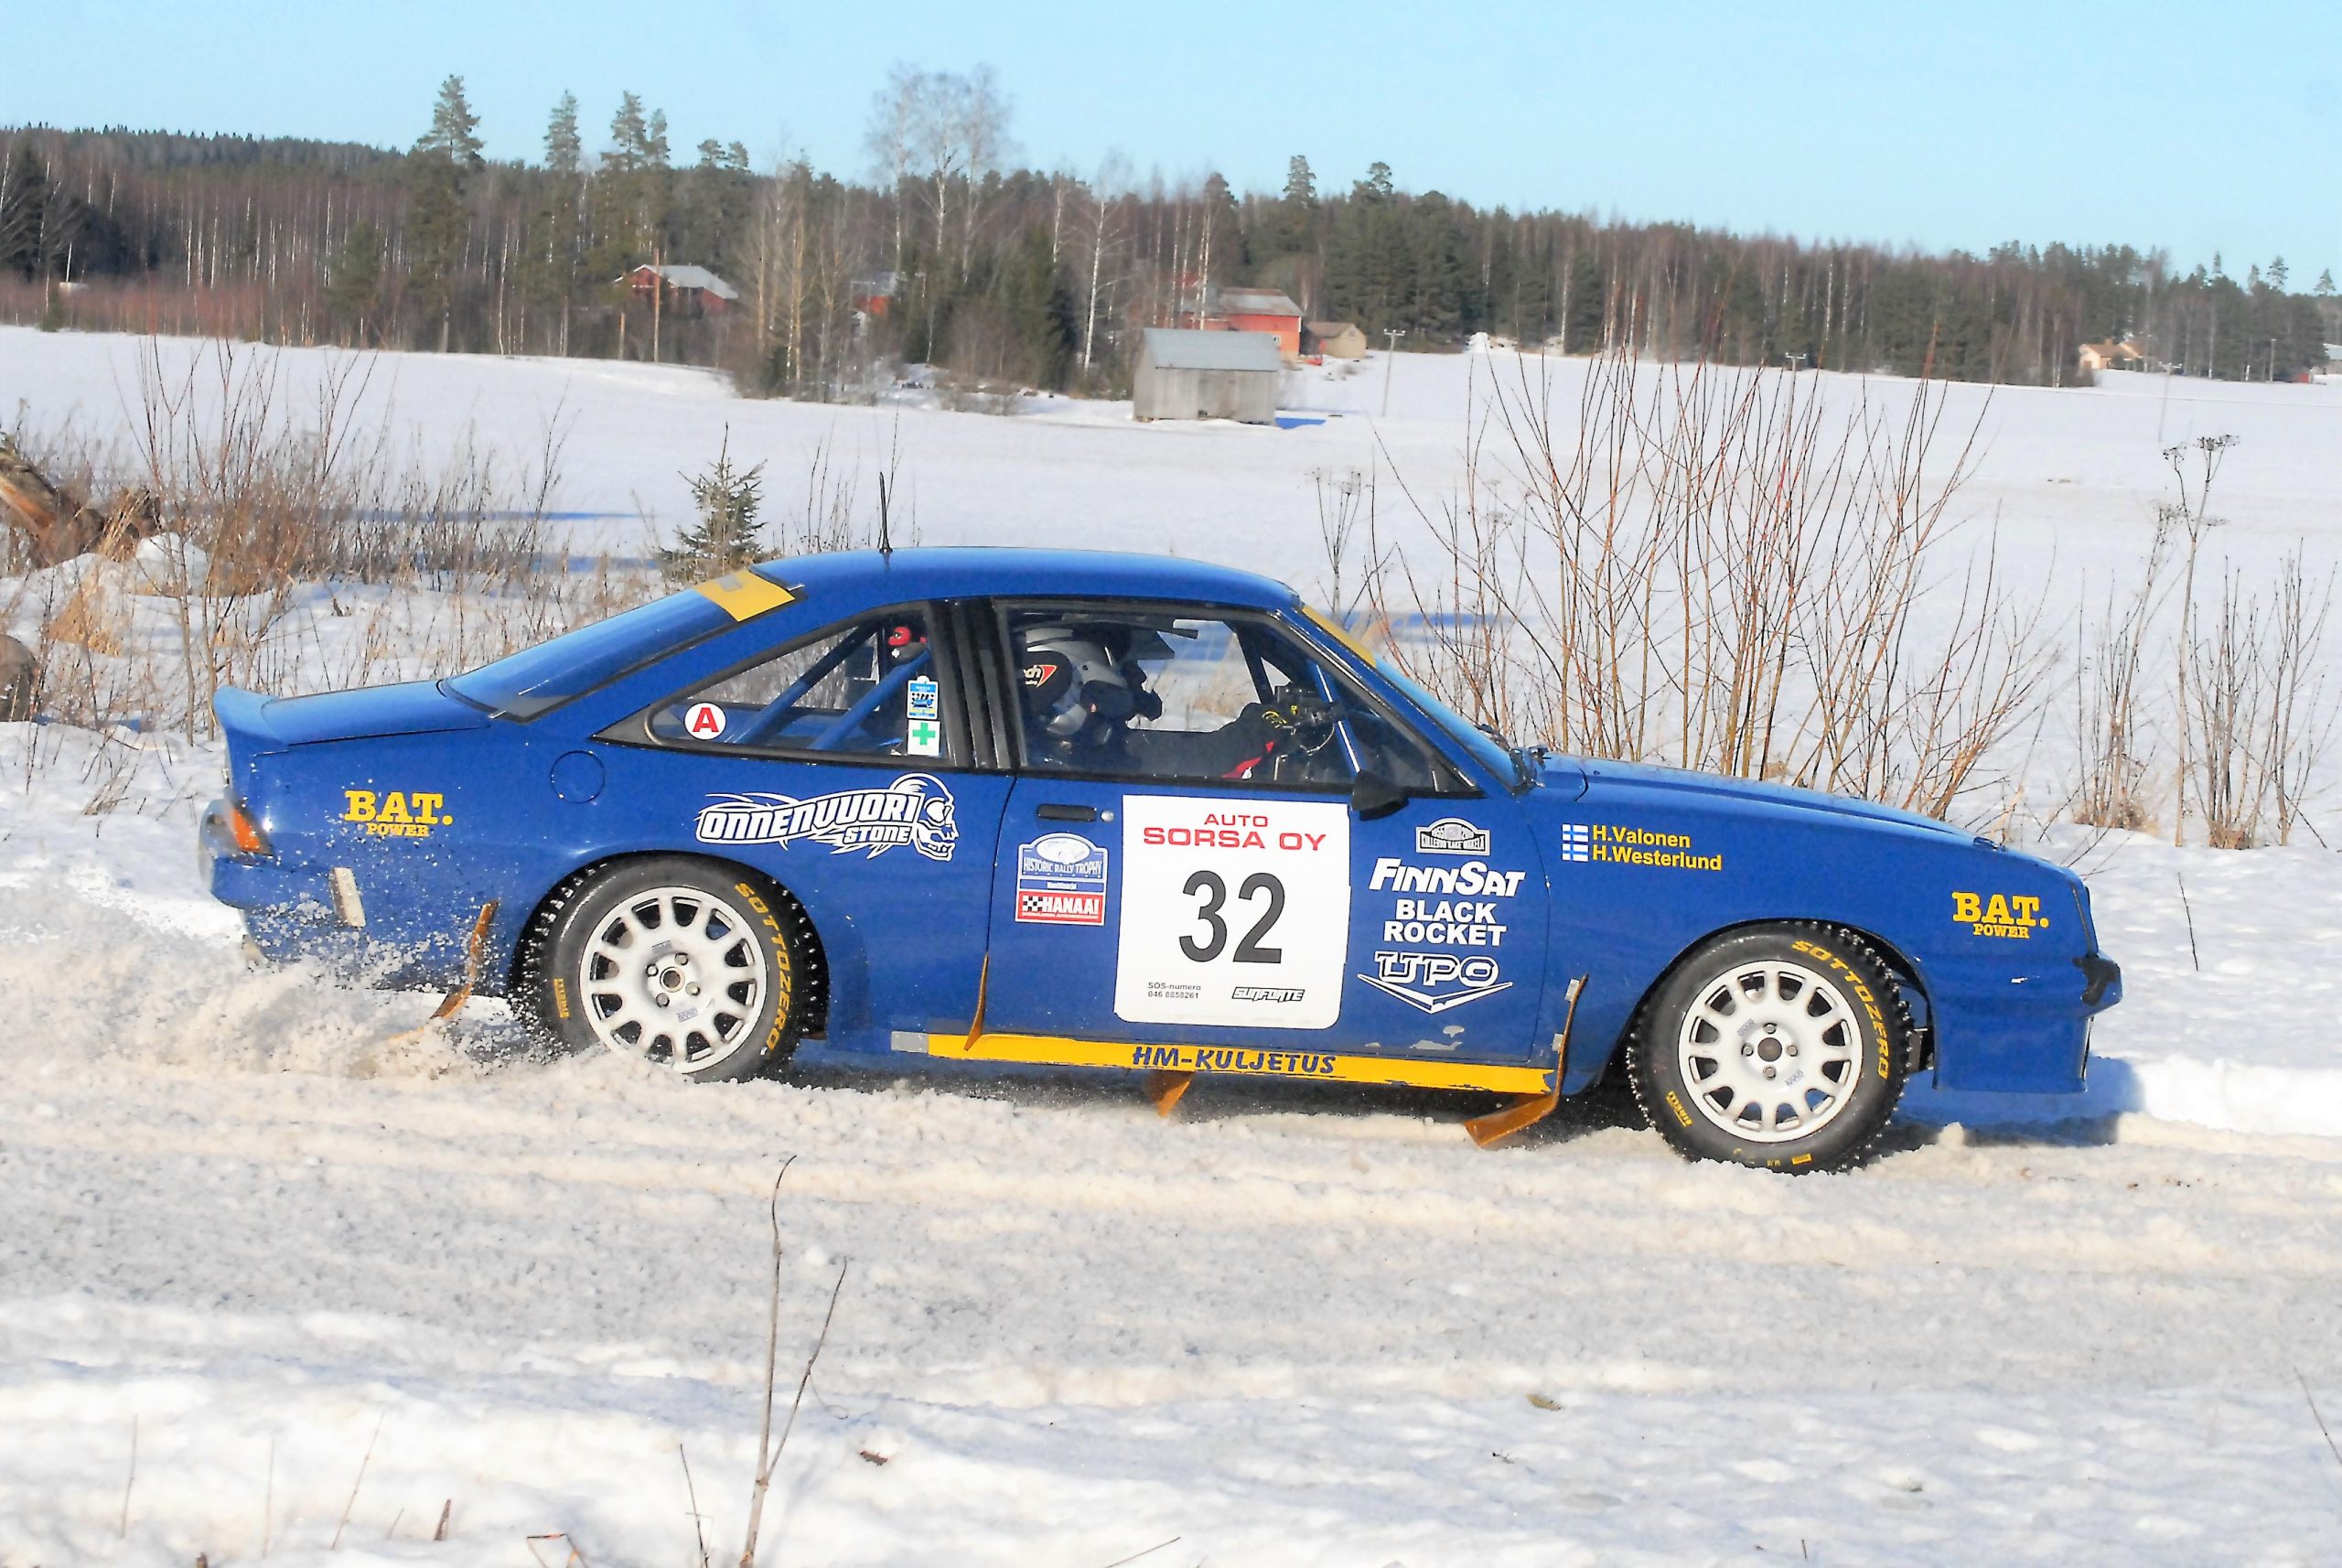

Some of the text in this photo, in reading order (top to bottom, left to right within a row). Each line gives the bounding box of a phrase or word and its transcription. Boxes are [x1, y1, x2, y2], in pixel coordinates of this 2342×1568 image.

[693, 707, 719, 733] A
[344, 790, 454, 825] BAT.
[700, 792, 914, 841] ONNENVUORI
[1204, 814, 1268, 827] AUTO
[366, 823, 430, 837] POWER
[843, 825, 910, 843] STONE
[1144, 827, 1327, 851] SORSA OY
[1593, 824, 1691, 848] H.Valonen
[1024, 856, 1102, 875] HISTORIC RALLY TROPHY
[1593, 844, 1723, 871] H.Westerlund
[1179, 870, 1285, 963] 32
[1396, 899, 1497, 924] BLACK
[1951, 892, 2049, 928] BAT.
[1383, 920, 1508, 946] ROCKET
[1973, 923, 2030, 939] POWER
[735, 883, 791, 1050] SOTTOZERO
[1375, 950, 1499, 987] UPO
[1148, 983, 1201, 991] SOS-numero
[1791, 940, 1889, 1079] SOTTOZERO
[1133, 1046, 1337, 1074] HM-KULJETUS
